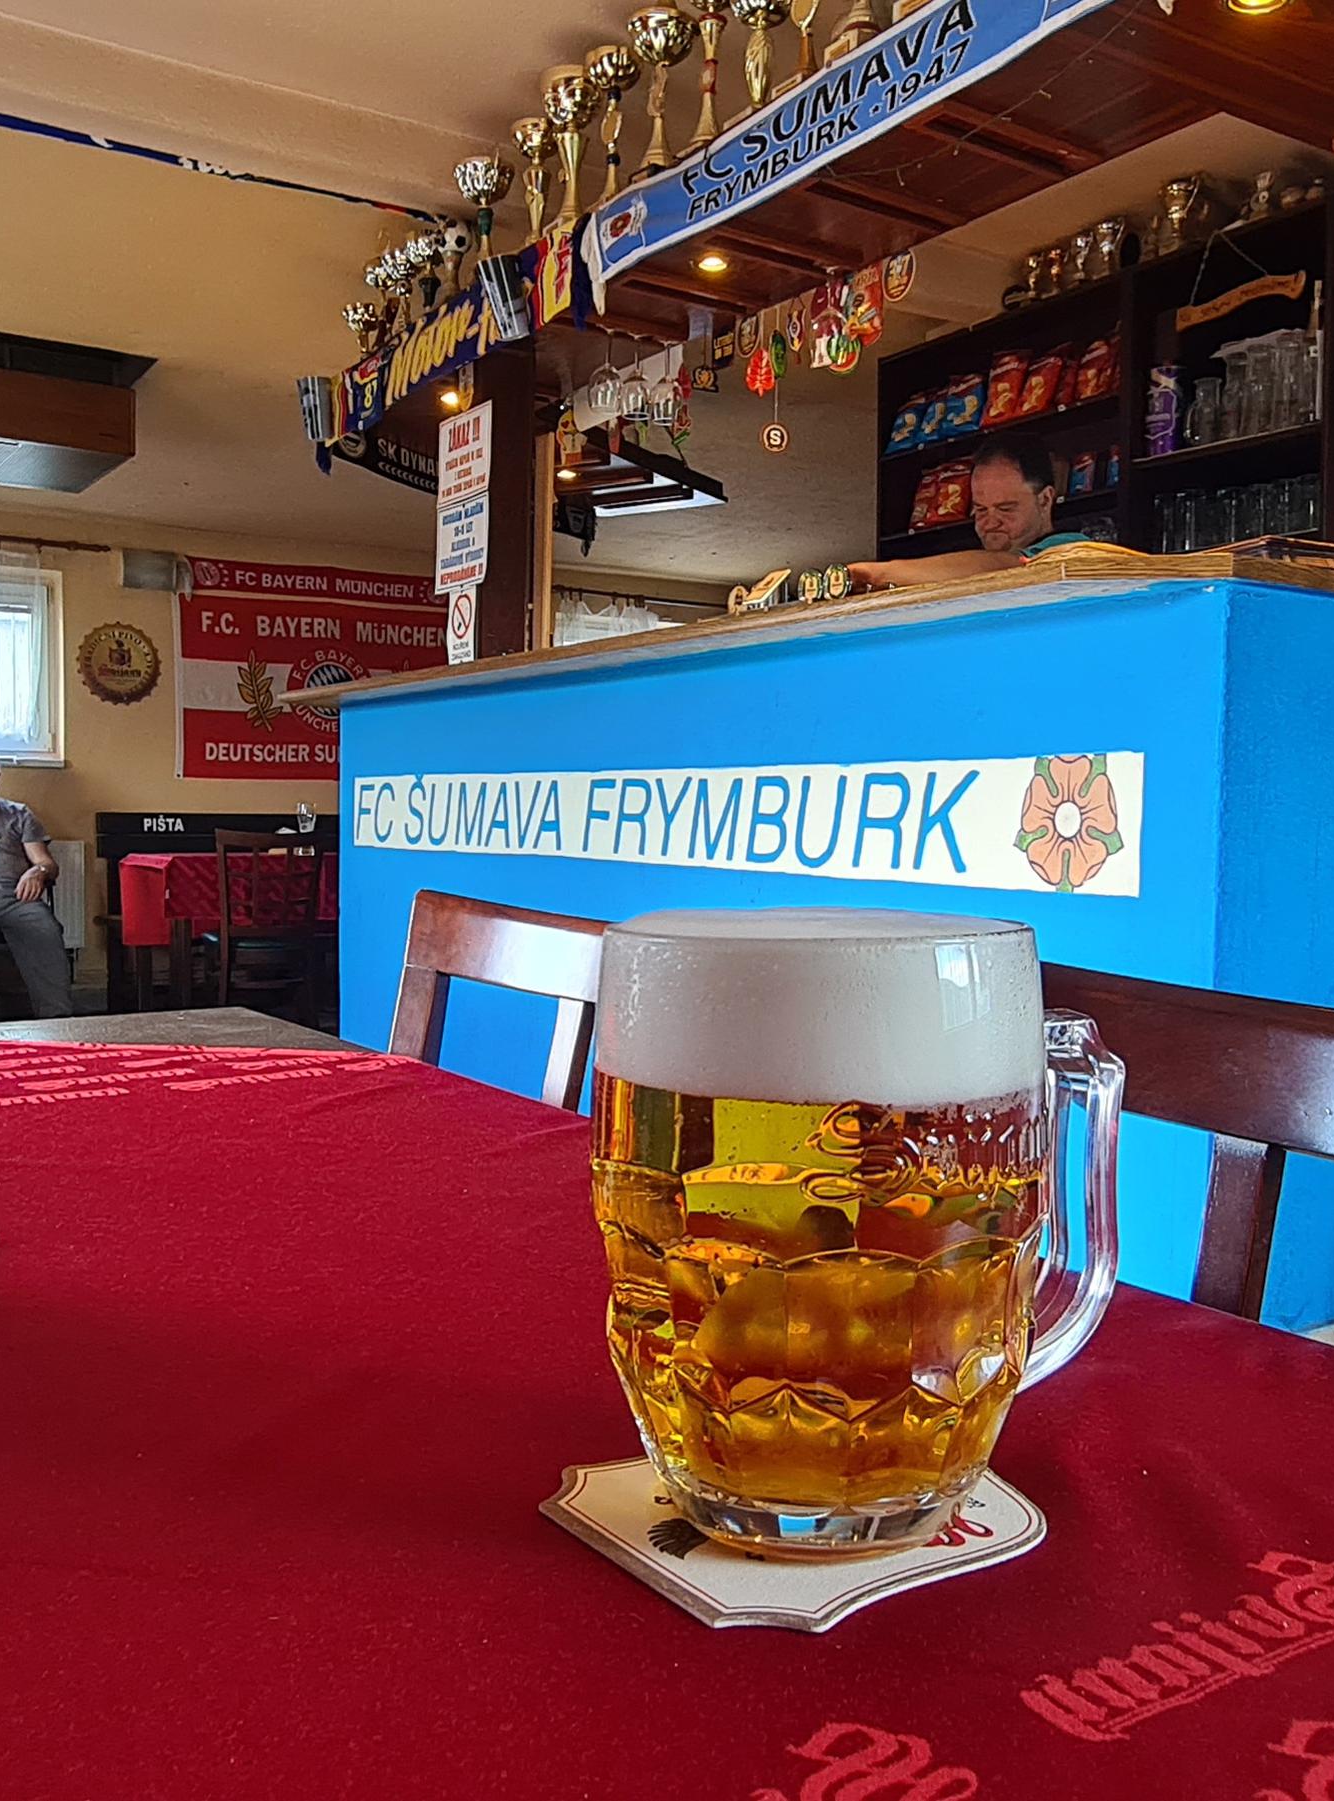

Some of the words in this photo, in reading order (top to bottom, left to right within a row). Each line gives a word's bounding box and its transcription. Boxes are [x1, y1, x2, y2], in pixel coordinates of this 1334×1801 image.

[681, 152, 734, 196] FC
[687, 112, 859, 221] FRYMBURK
[377, 438, 399, 463] SK
[400, 450, 440, 478] DYNA
[235, 570, 257, 586] FC
[261, 574, 328, 591] BAYERN
[335, 576, 415, 598] MÜNCHEN
[201, 611, 240, 635] F.C.
[256, 615, 341, 640] BAYERN
[314, 649, 364, 675] BAYER
[205, 742, 310, 763] DEUTSCHER
[314, 743, 339, 763] SU
[143, 814, 185, 832] PIŠTA
[356, 782, 396, 844] FC
[404, 772, 563, 852] ŠUMAVA
[581, 769, 981, 874] FRYMBURK
